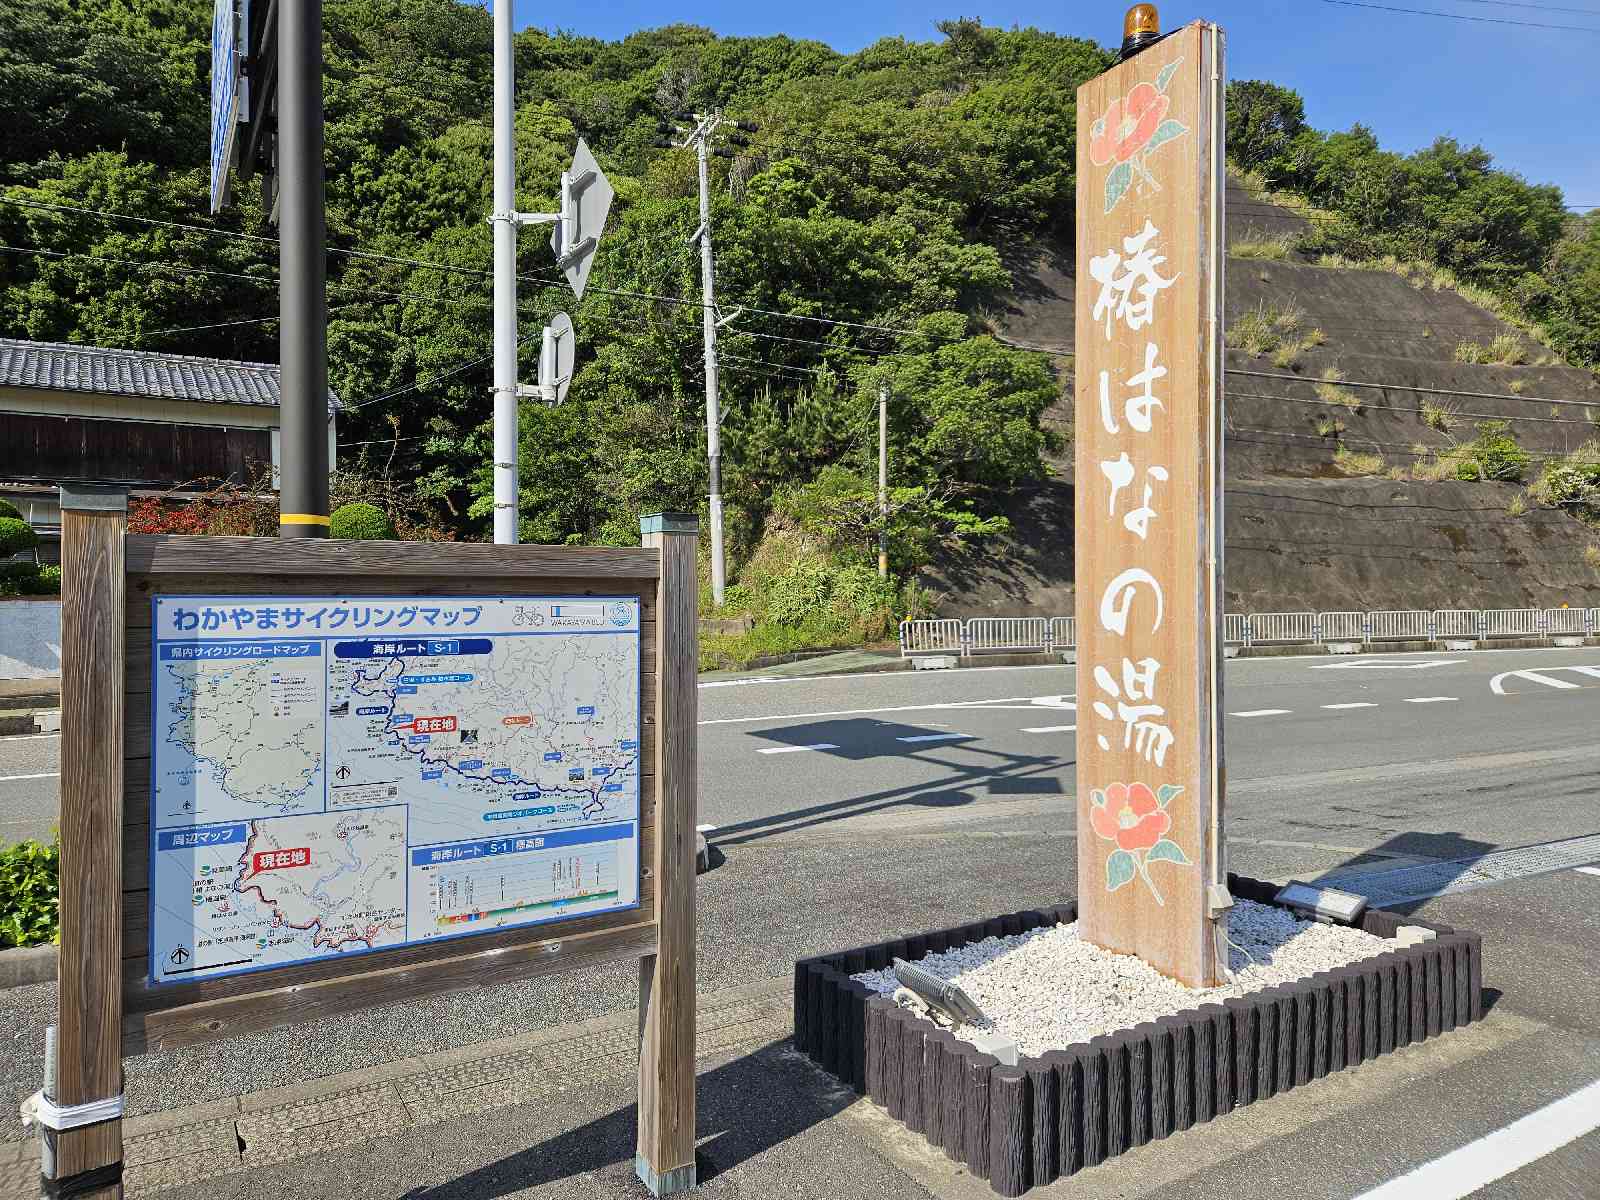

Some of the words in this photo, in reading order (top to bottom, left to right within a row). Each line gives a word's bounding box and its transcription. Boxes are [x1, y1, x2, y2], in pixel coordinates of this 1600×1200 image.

[1088, 219, 1182, 768] 椿はなの湯
[173, 606, 483, 631] わかやまサイクリングマップ
[171, 644, 310, 658] 県内サイクリングロードマップ
[372, 643, 426, 655] 海岸ルート
[434, 643, 453, 653] S-1
[416, 718, 454, 733] 現在地
[172, 829, 234, 846] 周辺マップ
[259, 850, 305, 869] 現在地
[431, 844, 482, 861] 海岸ルート
[490, 842, 507, 853] S-1
